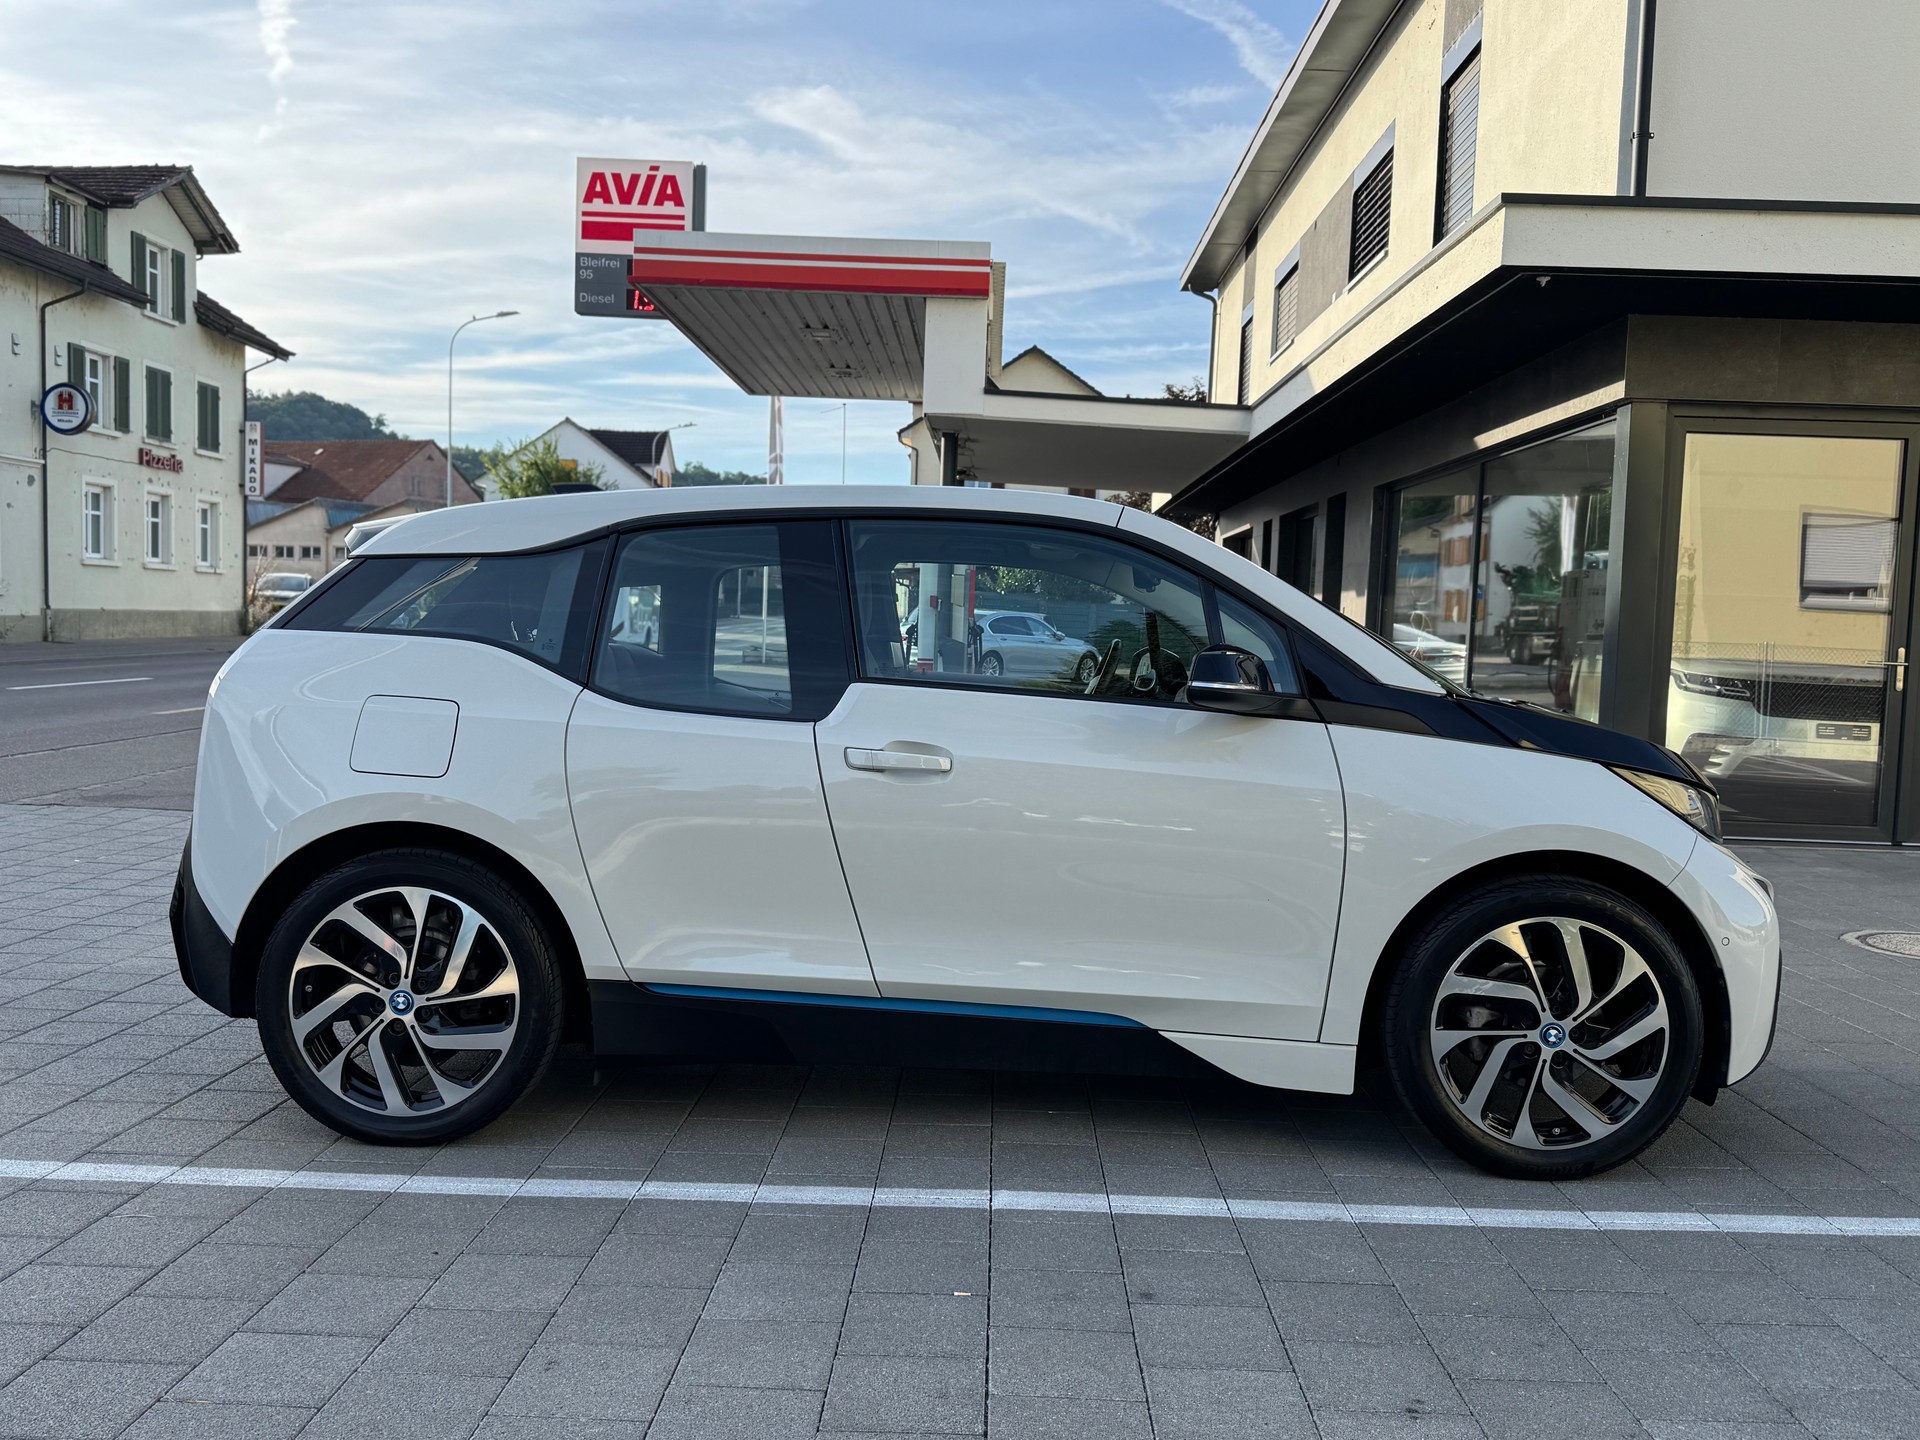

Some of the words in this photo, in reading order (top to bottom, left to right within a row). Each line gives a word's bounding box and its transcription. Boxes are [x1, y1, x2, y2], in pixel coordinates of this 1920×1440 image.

[582, 165, 685, 207] AVIA
[579, 257, 620, 268] Bleifrei
[579, 270, 594, 279] 95
[579, 292, 615, 303] Diesel
[141, 448, 184, 472] Pizzeria
[248, 438, 258, 493] MIKADO
